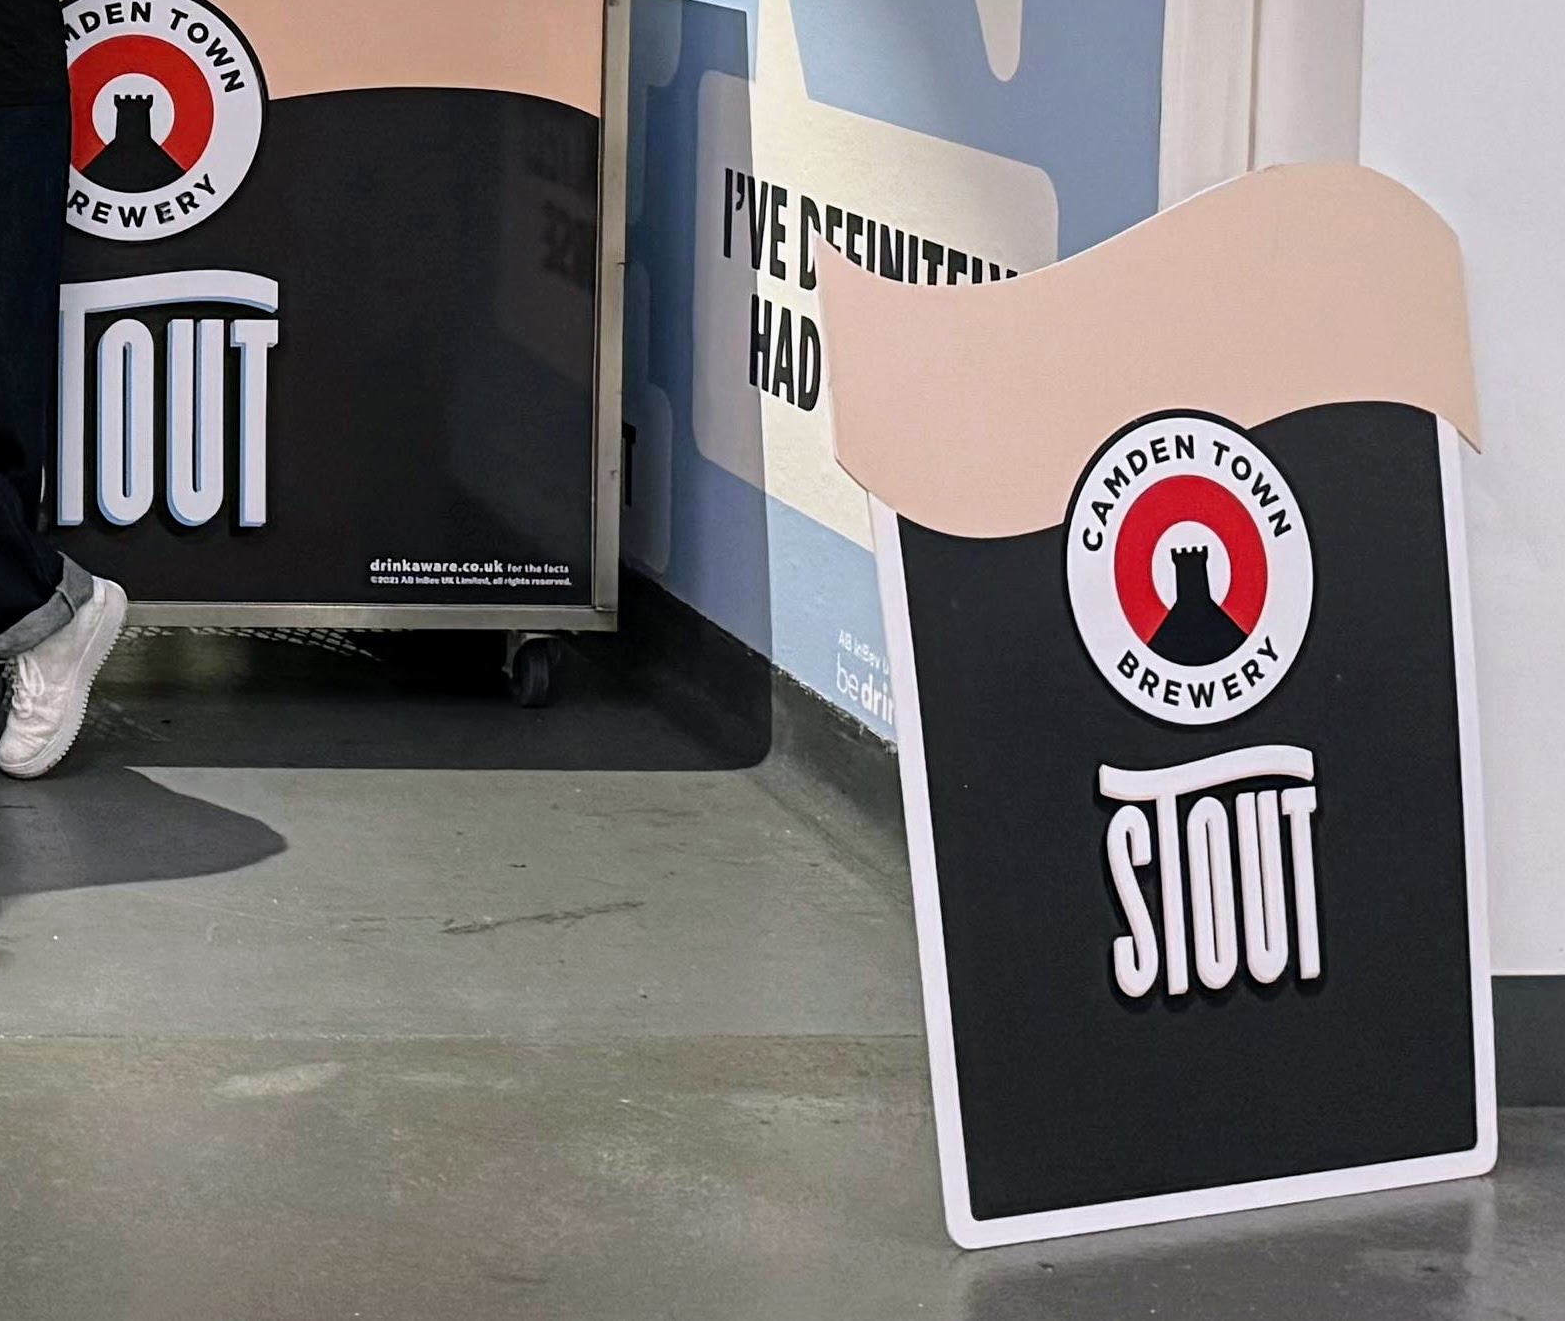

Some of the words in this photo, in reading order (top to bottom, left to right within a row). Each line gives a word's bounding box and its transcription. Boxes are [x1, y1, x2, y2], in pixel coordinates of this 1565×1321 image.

[169, 8, 245, 93] TOWN
[723, 168, 787, 281] I'VE
[749, 293, 821, 412] HAD
[1082, 434, 1196, 553] CAMDEN
[1212, 441, 1292, 538] TOWN
[370, 558, 503, 572] drinkaware.co.uk
[507, 563, 522, 573] for
[524, 563, 541, 573] the
[544, 563, 569, 573] facts
[441, 576, 454, 585] UK
[504, 576, 530, 586] rights
[838, 629, 852, 651] AB
[1115, 637, 1280, 709] BREWERY
[1098, 744, 1318, 998] STOUT
